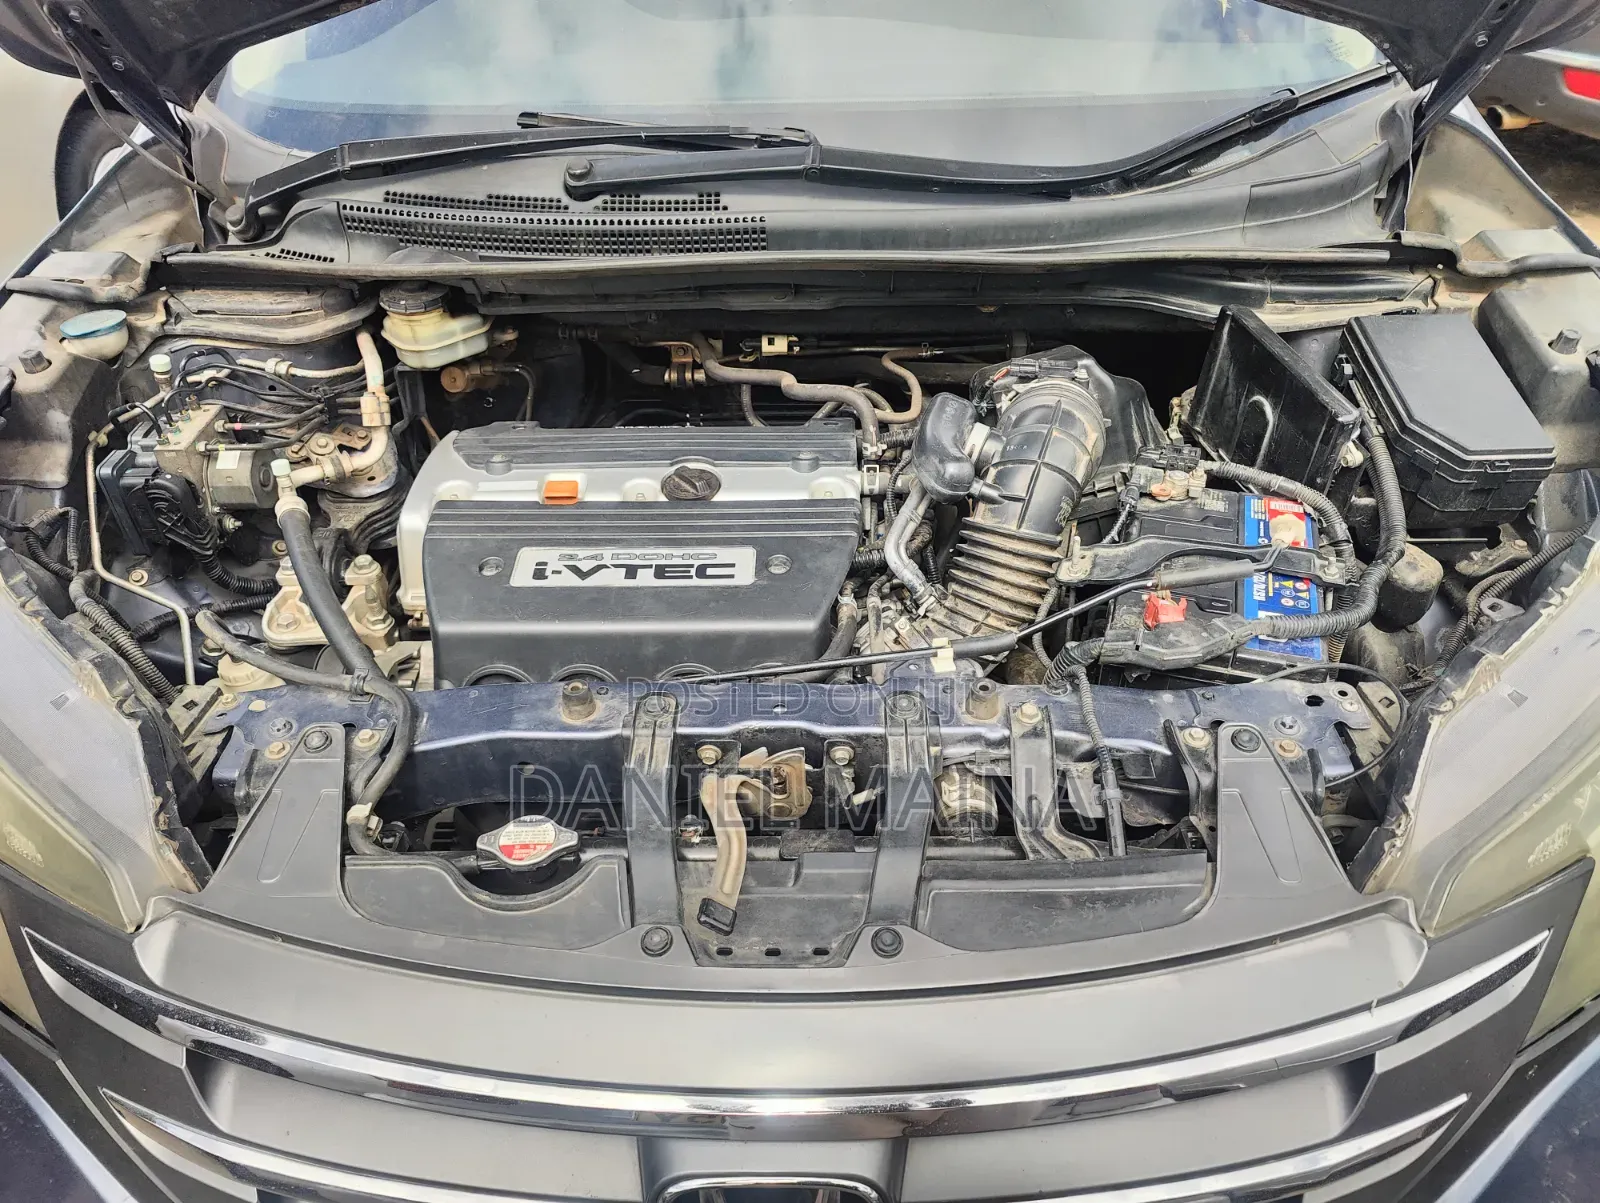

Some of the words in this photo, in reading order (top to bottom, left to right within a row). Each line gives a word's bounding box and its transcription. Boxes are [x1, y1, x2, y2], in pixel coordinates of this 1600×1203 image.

[558, 552, 604, 562] 2.4
[611, 552, 717, 561] DOHC
[532, 561, 736, 581] i-VTEC
